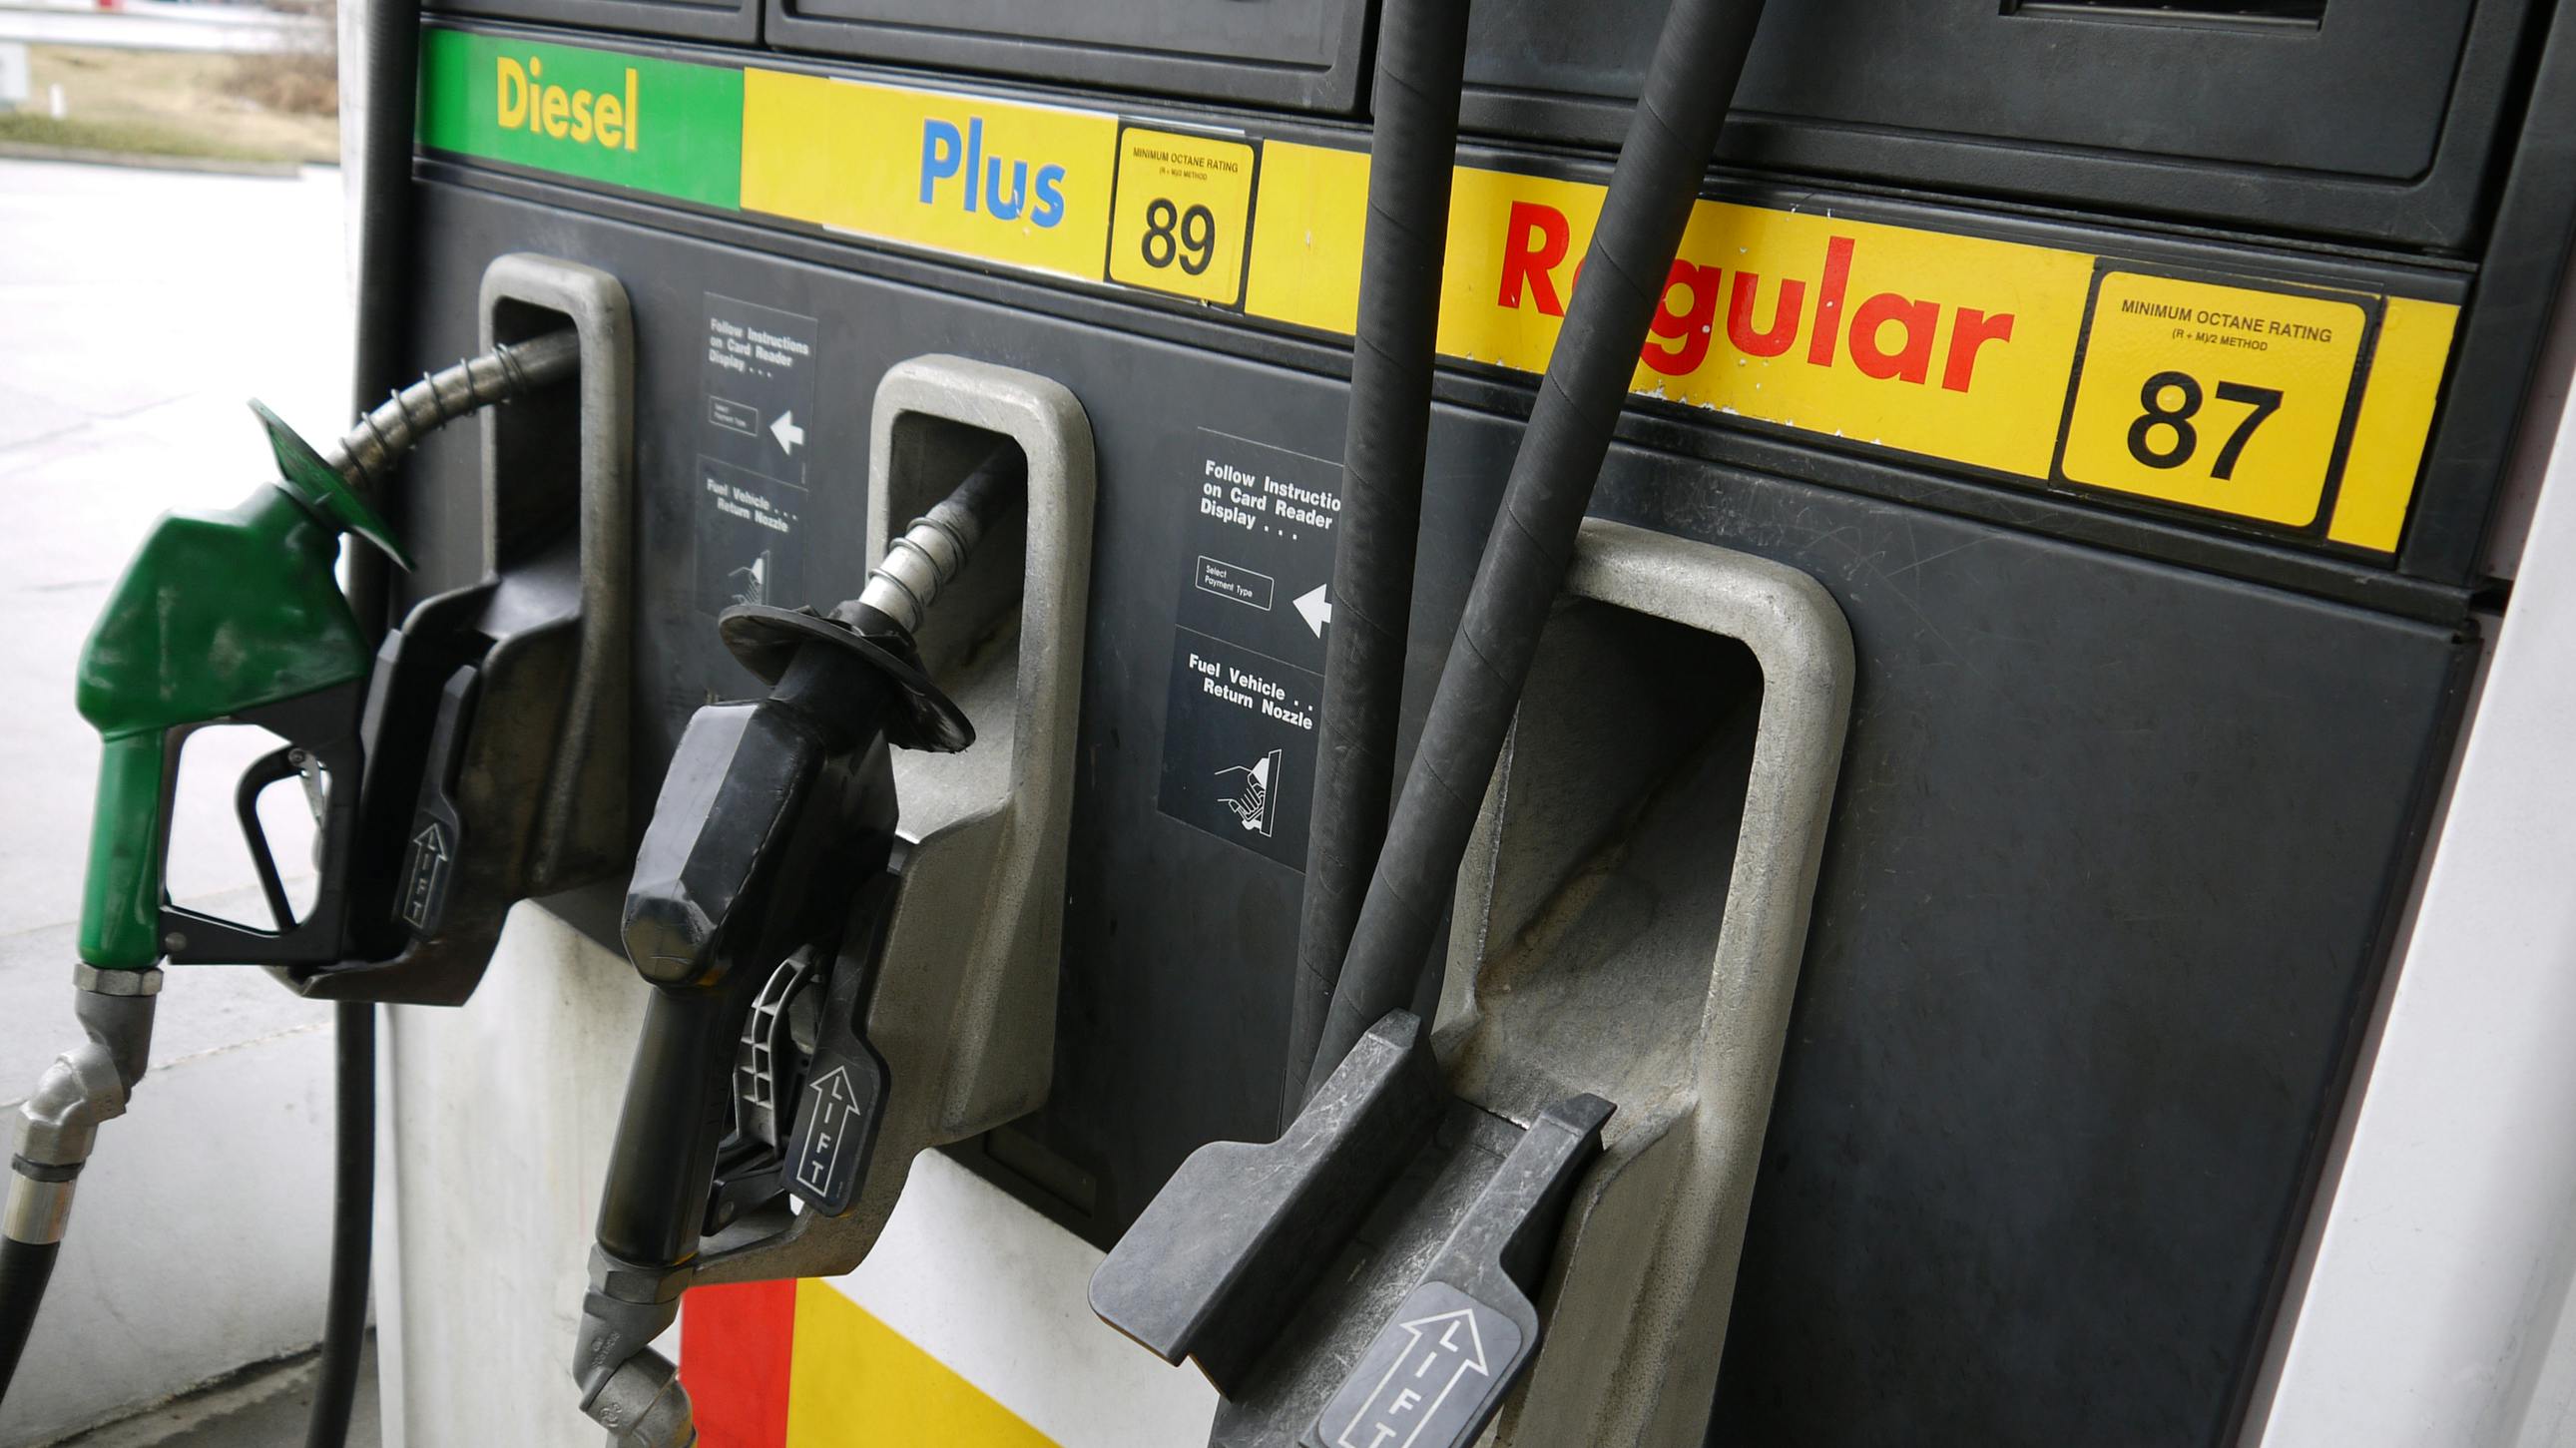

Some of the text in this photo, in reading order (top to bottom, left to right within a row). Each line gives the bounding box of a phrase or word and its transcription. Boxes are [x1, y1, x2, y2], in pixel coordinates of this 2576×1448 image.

[497, 56, 638, 151] Diesel
[919, 116, 1066, 229] Plus
[1133, 148, 1239, 173] MINIMUM OCTANE RATING
[1142, 198, 1215, 275] 89
[1498, 201, 2015, 393] Rgular
[711, 317, 809, 355] Follow Instructions
[2121, 299, 2332, 343] MINIMUM OCTANE RATING
[2220, 335, 2268, 351] METHOD
[709, 348, 745, 372] Display
[710, 336, 792, 366] on Card Reader
[2127, 371, 2285, 480] 87
[707, 478, 728, 497] Fuel
[734, 486, 770, 511] Vehicle
[1203, 483, 1332, 530] on Card Reader
[1205, 459, 1341, 511] Follow Instructio
[717, 496, 788, 533] Return Nozzle
[1201, 498, 1256, 530] Display
[1205, 575, 1253, 597] Payment Type
[1206, 564, 1227, 578] Select
[1189, 653, 1221, 678] Fuel
[1230, 667, 1286, 701] Vehicle
[1204, 678, 1312, 729] Return Nozzle
[811, 1076, 842, 1184] LIFT
